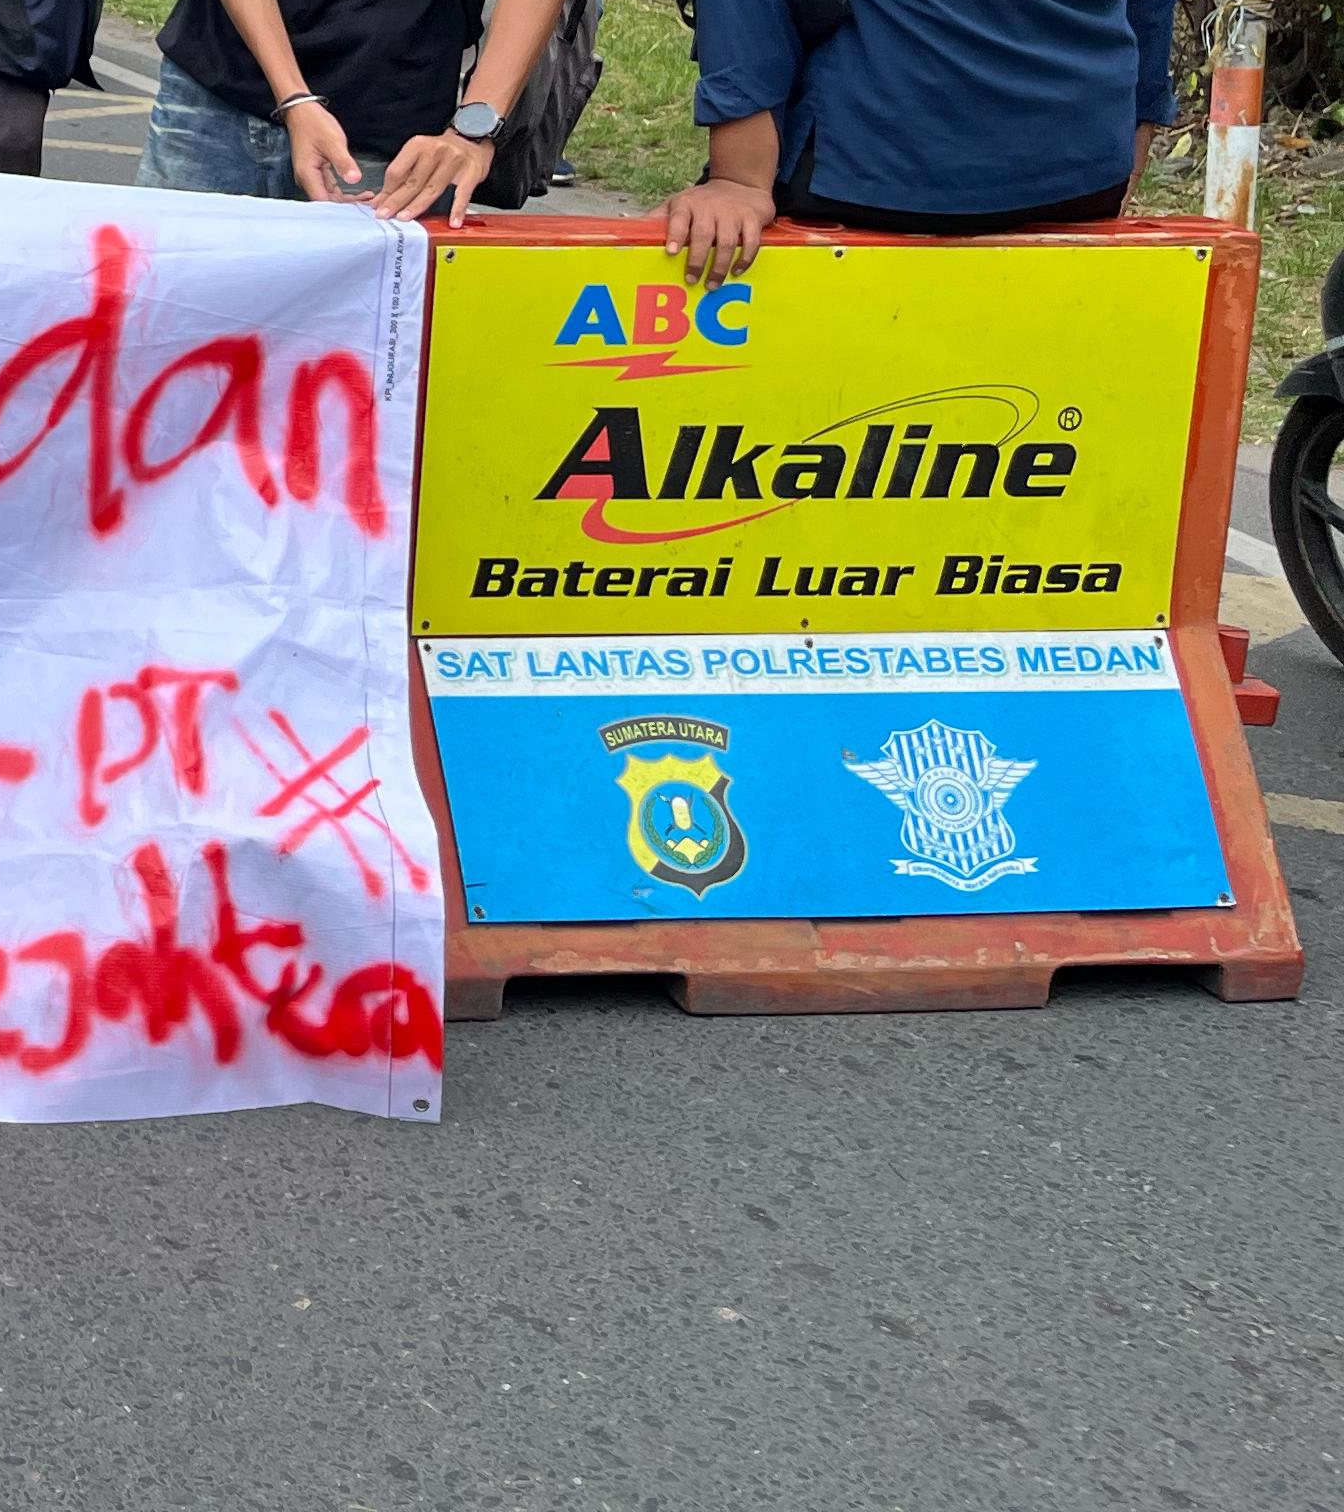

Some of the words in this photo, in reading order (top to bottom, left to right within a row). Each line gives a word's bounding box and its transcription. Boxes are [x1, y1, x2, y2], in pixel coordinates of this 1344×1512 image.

[553, 283, 753, 347] ABC
[535, 406, 1079, 502] Alkaline
[469, 556, 731, 599] Baterai
[756, 557, 915, 598] Luar
[935, 554, 1123, 595] Biasa
[436, 649, 515, 682] SAT
[527, 648, 692, 680] LANTAS
[703, 645, 1007, 678] POLRESTABES
[1018, 643, 1162, 676] MEDAN
[75, 664, 240, 828] PT
[605, 720, 677, 748] SUMATERA
[678, 722, 725, 747] UTARA
